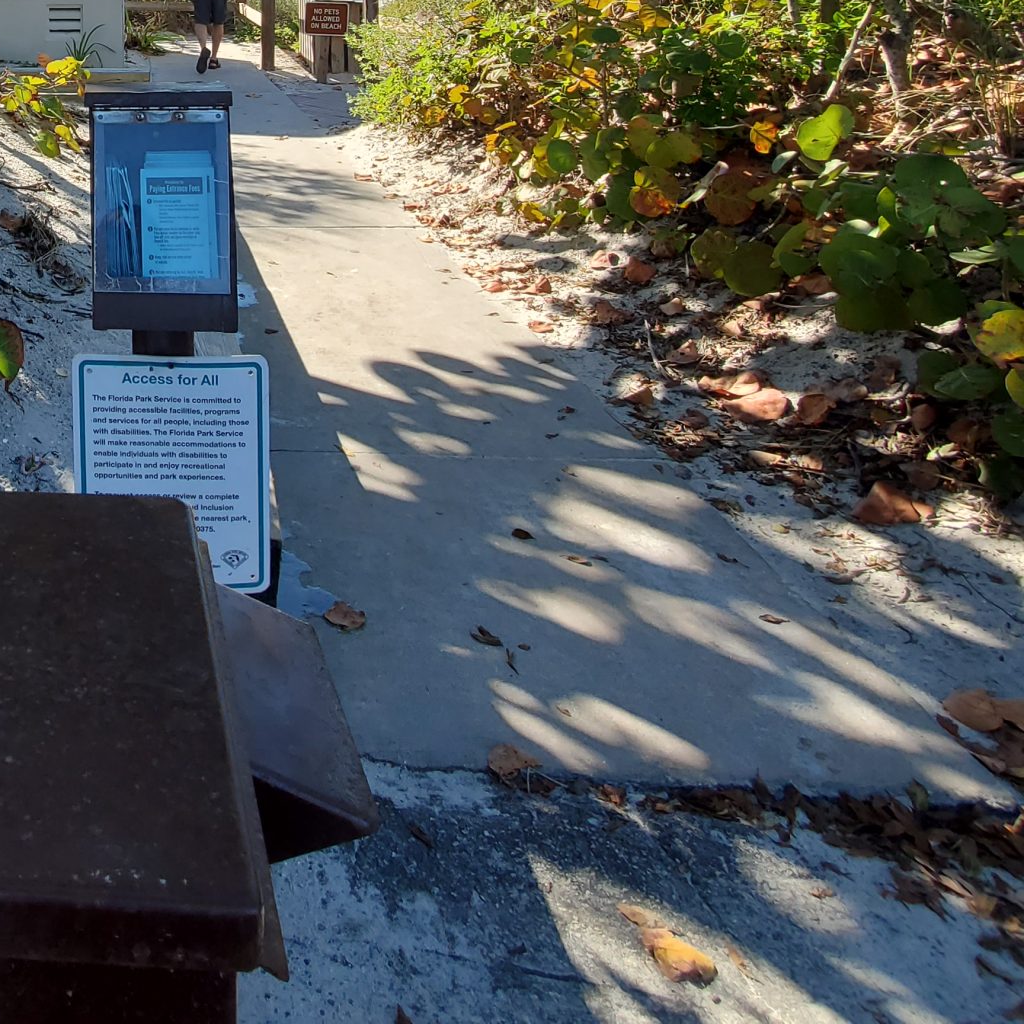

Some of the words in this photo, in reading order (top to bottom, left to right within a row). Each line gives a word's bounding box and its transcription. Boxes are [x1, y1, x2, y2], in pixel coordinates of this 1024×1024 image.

[122, 373, 173, 384] Access
[178, 374, 197, 385] for
[201, 375, 218, 385] All
[154, 396, 181, 404] Service
[93, 406, 126, 415] providing
[193, 419, 226, 428] including
[170, 429, 194, 437] Florida
[120, 451, 159, 459] individuals
[160, 462, 179, 471] enjoy
[161, 473, 176, 481] park
[205, 494, 239, 502] complete
